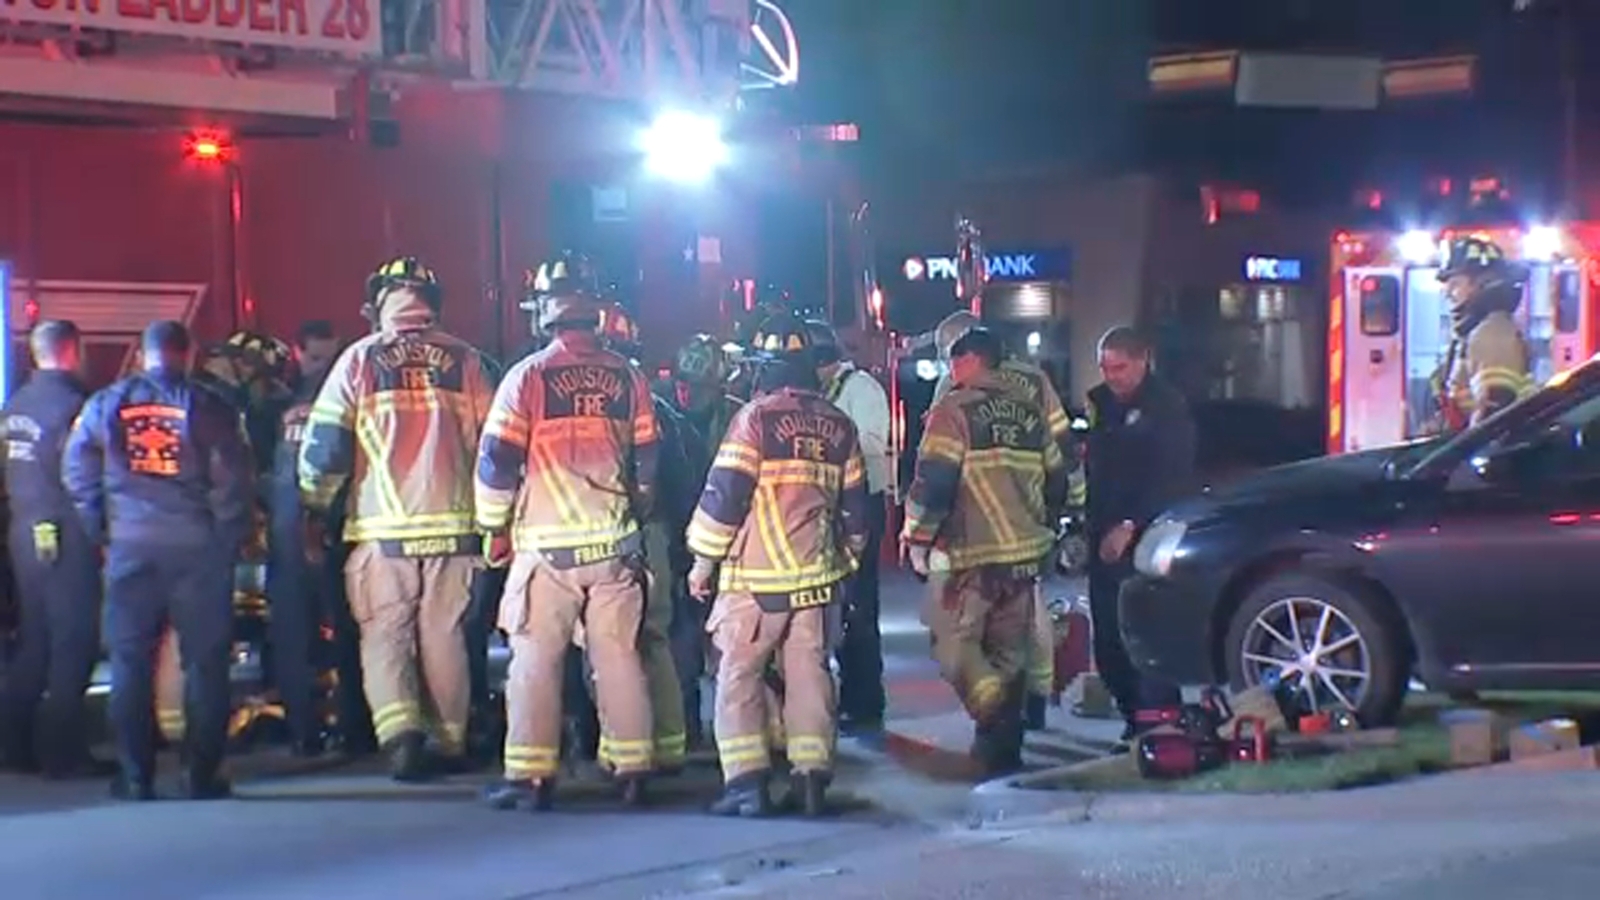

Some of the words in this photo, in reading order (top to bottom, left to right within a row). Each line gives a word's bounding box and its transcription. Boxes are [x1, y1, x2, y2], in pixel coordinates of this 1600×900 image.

[321, 0, 370, 40] 28
[926, 256, 960, 280] PN
[549, 365, 623, 401] HOUSTON
[789, 586, 832, 608] KELLY
